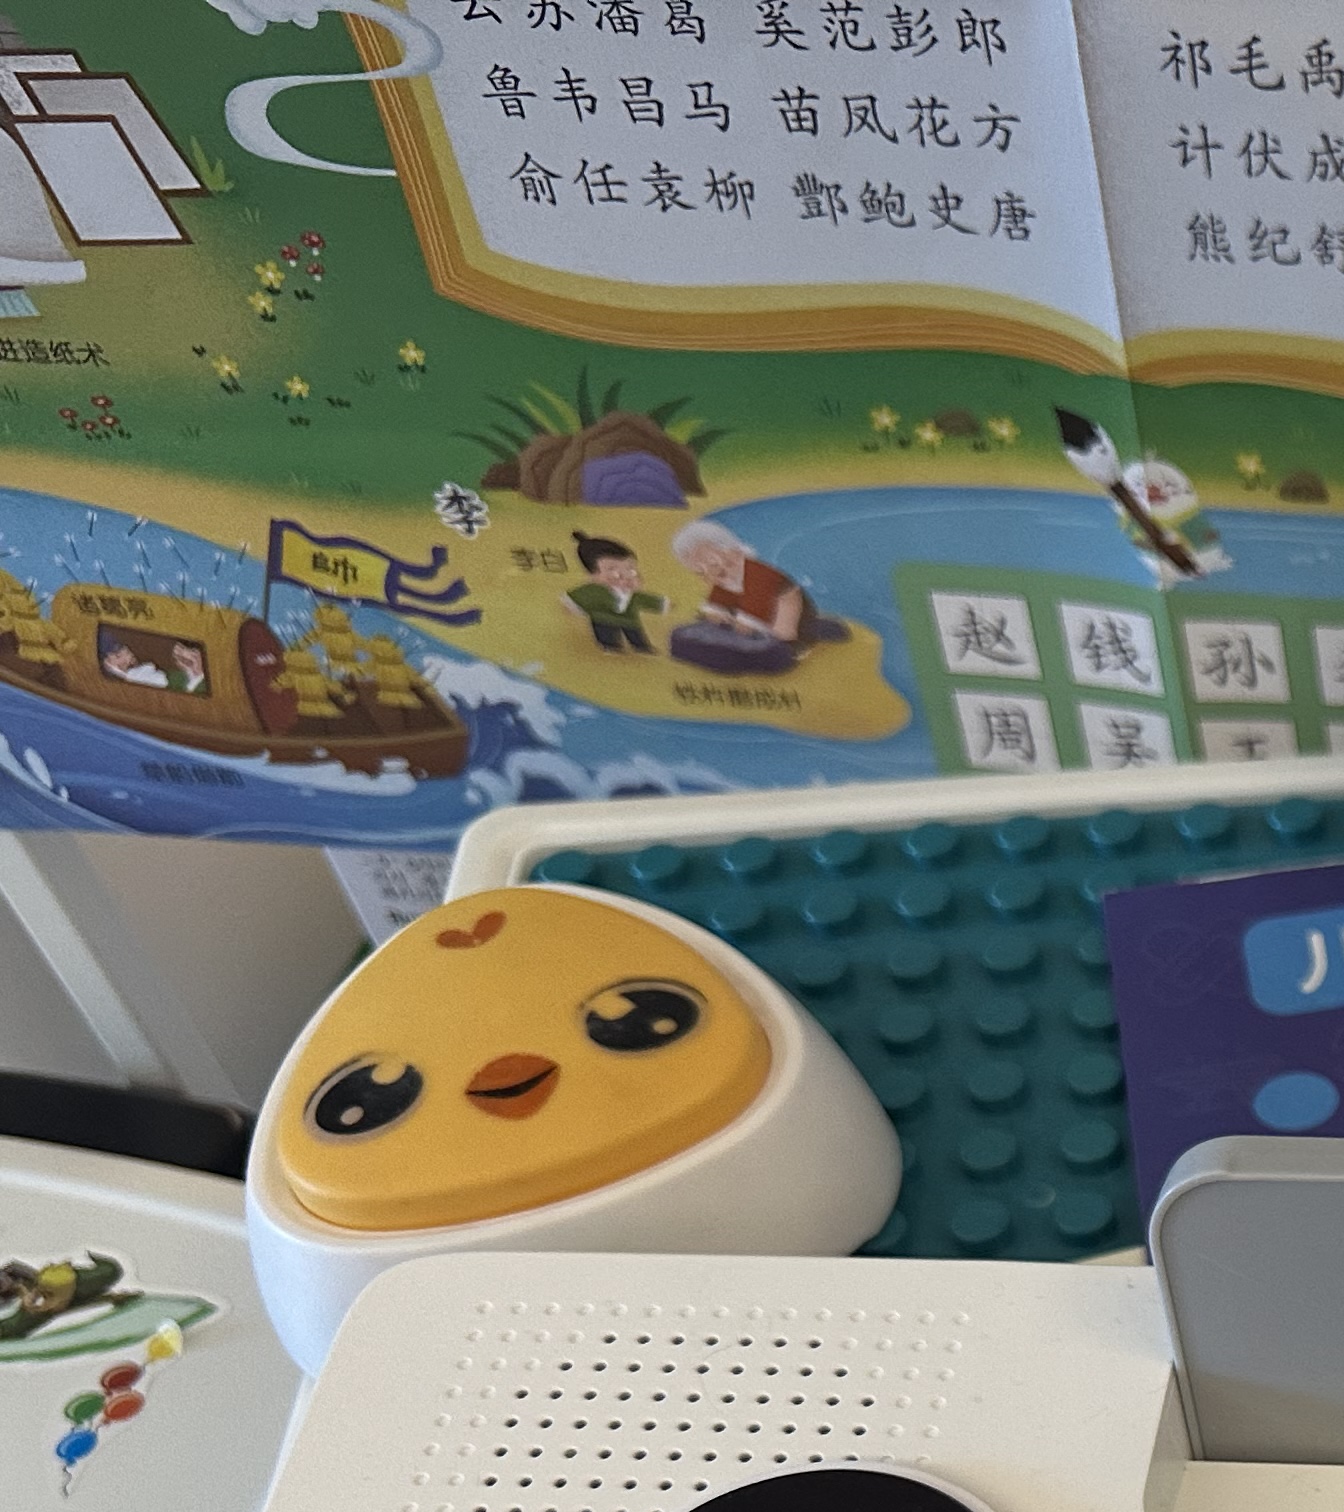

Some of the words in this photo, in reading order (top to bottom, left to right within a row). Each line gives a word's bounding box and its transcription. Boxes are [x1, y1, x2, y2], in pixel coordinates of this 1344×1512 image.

[482, 63, 731, 133] 鲁韦昌马
[771, 85, 1022, 153] 苗凤花方
[509, 152, 756, 221] 俞任袁柳
[791, 172, 1037, 242] 酆鲍史唐
[953, 605, 1026, 668] 赵
[1080, 612, 1152, 686] 钱
[1200, 630, 1277, 690] 孙
[979, 704, 1038, 764] 周
